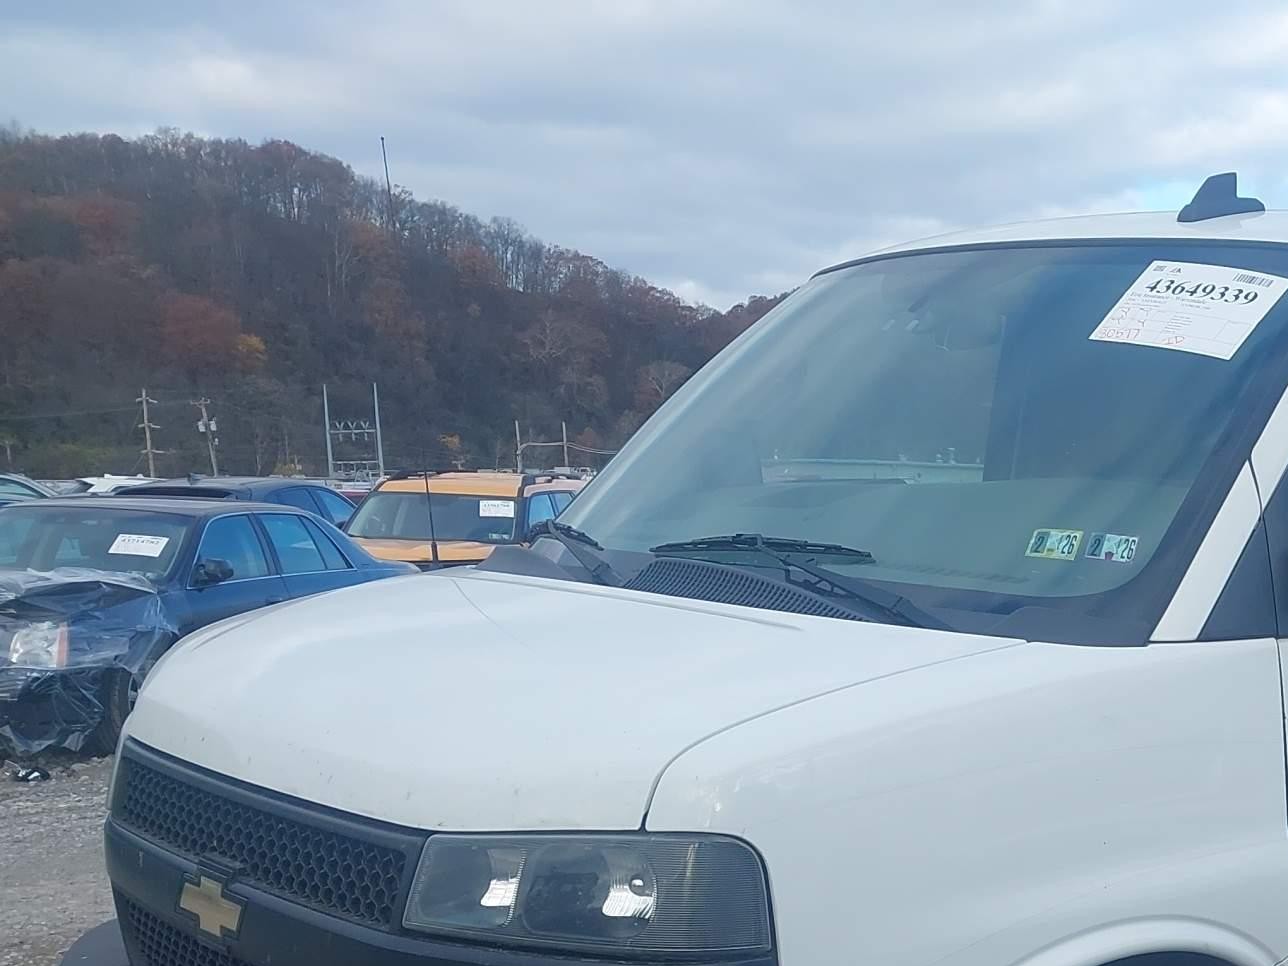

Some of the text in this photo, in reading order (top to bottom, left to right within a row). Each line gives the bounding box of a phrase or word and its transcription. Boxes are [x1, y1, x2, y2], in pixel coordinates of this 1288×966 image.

[1145, 278, 1259, 306] 43649339
[1061, 534, 1078, 555] 26
[1120, 538, 1137, 560] 26
